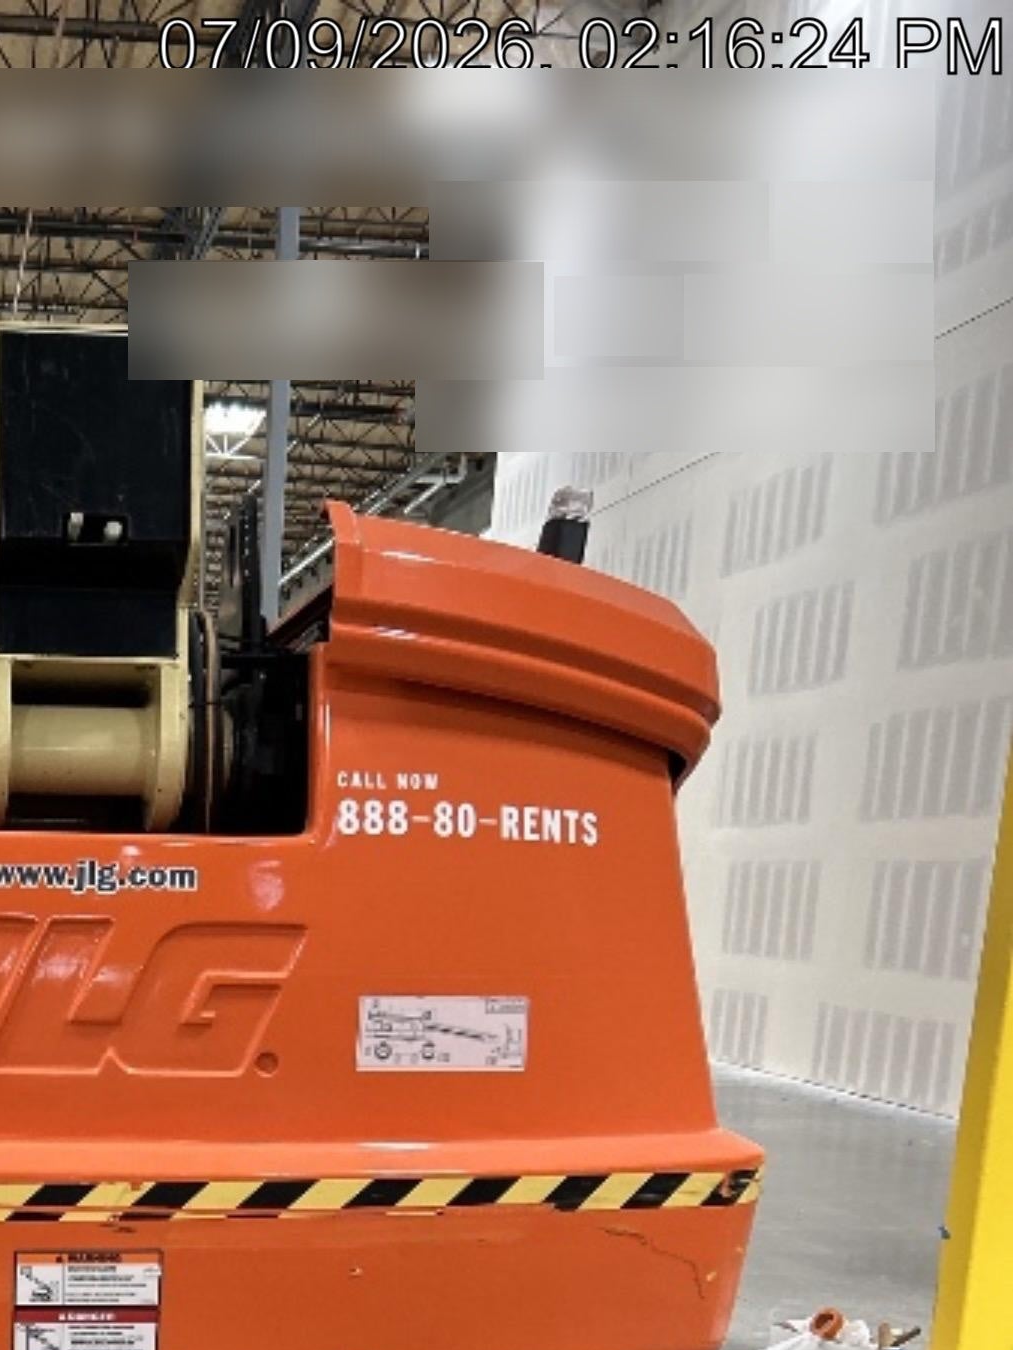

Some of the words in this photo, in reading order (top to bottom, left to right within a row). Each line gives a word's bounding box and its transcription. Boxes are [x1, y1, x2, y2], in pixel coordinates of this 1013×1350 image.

[338, 771, 387, 789] CALL
[397, 773, 438, 790] NOW
[338, 798, 599, 846] 888-80-RENTS
